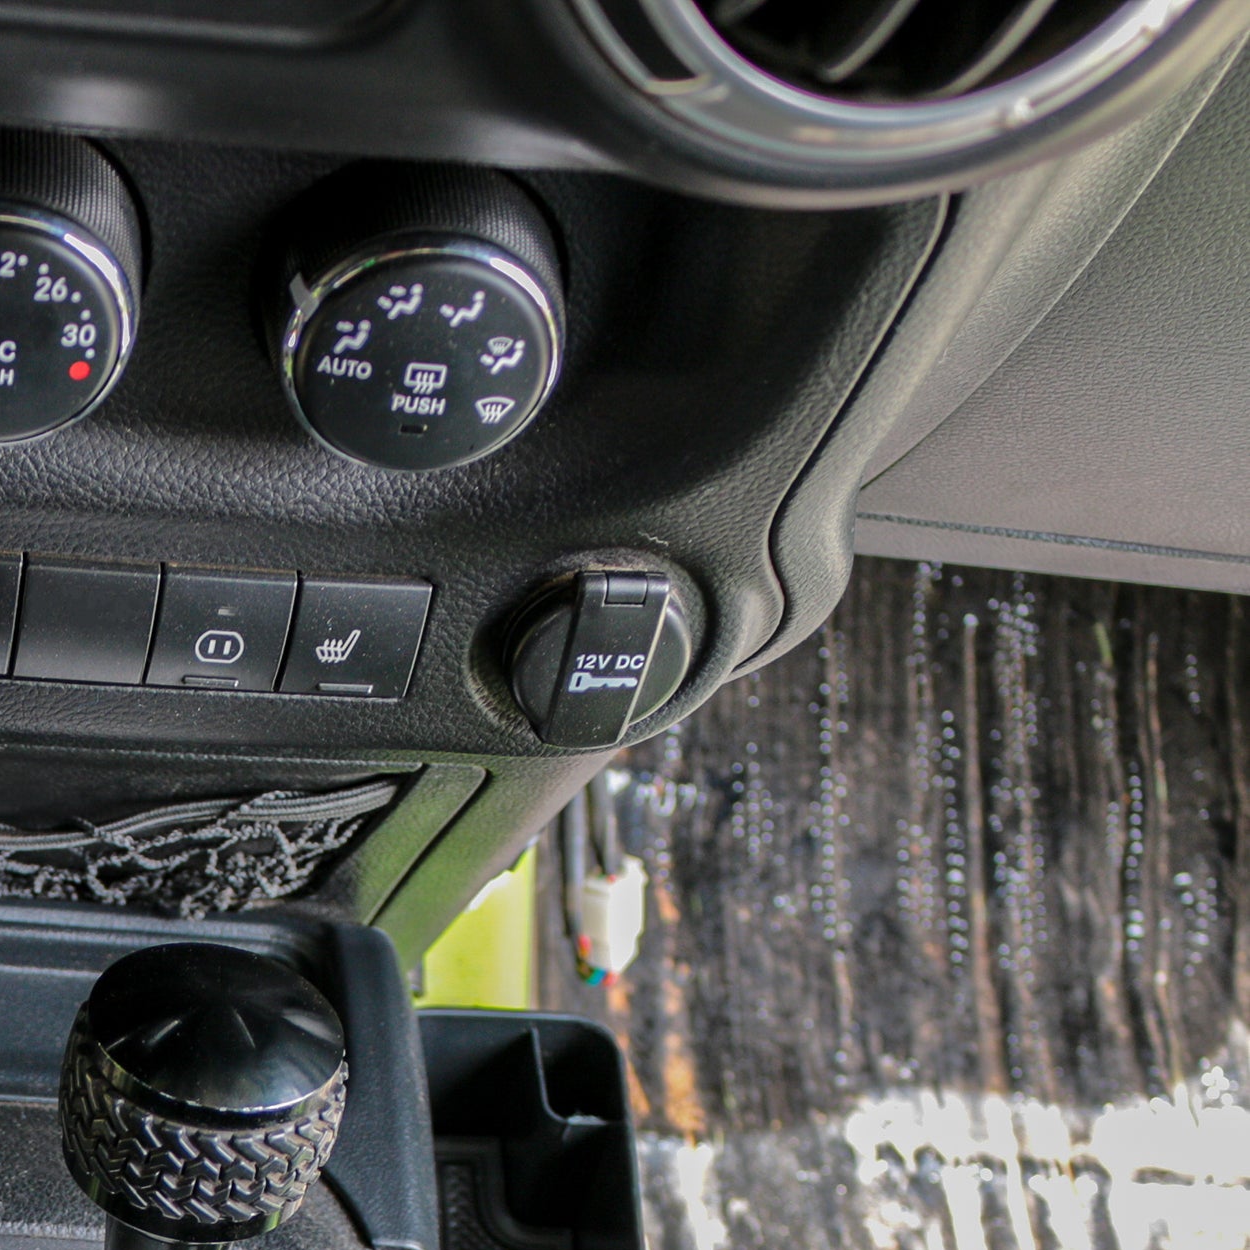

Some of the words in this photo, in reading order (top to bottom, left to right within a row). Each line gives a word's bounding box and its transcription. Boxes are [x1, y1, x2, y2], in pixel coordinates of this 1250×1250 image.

[34, 276, 68, 302] 26
[61, 323, 96, 347] 30
[317, 355, 372, 380] AUTO
[391, 394, 446, 415] PUSH
[576, 654, 611, 670] 12V
[615, 654, 645, 670] DC
